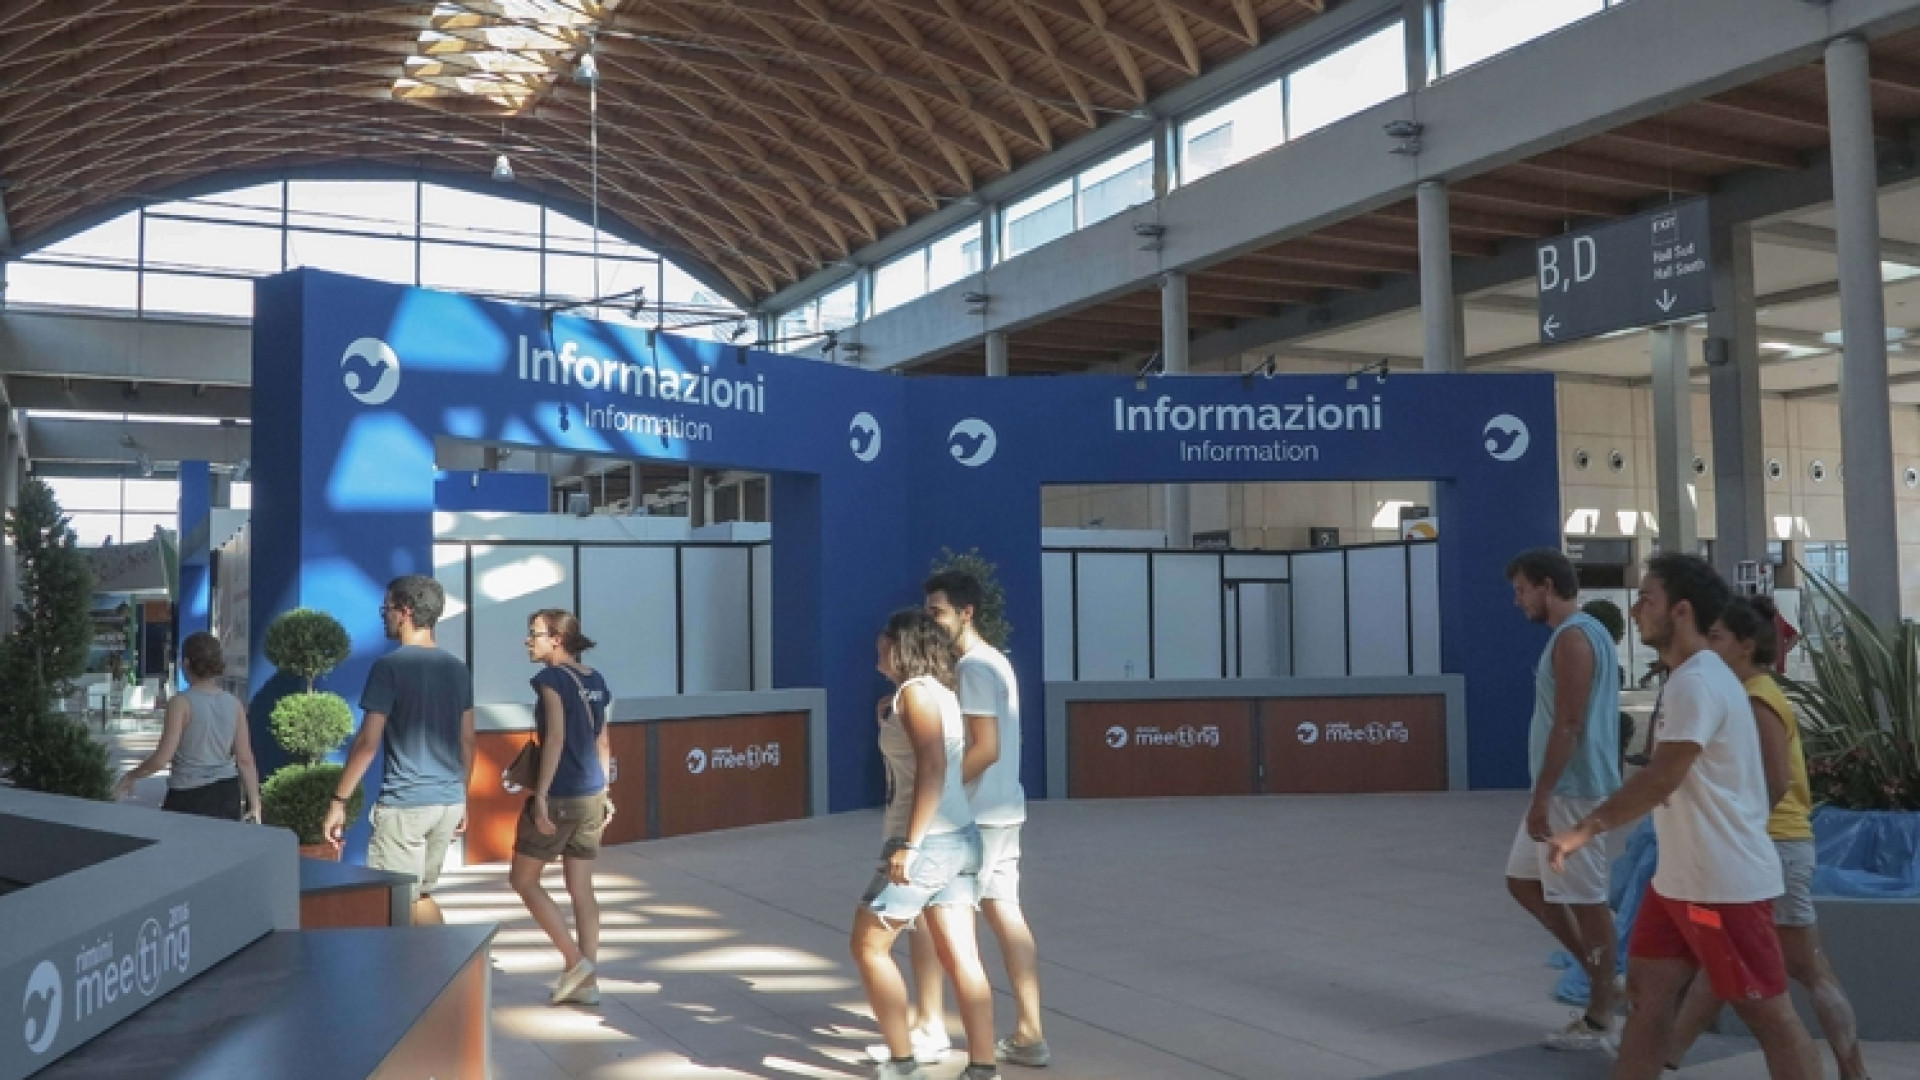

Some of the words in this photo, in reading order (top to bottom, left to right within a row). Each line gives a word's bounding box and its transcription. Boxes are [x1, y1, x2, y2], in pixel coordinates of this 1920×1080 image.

[1538, 235, 1596, 292] B,D
[518, 334, 765, 413] Informazioni
[584, 403, 713, 441] Information
[1114, 395, 1383, 432] Informazioni
[1180, 440, 1319, 462] Information
[76, 919, 190, 1021] meeting
